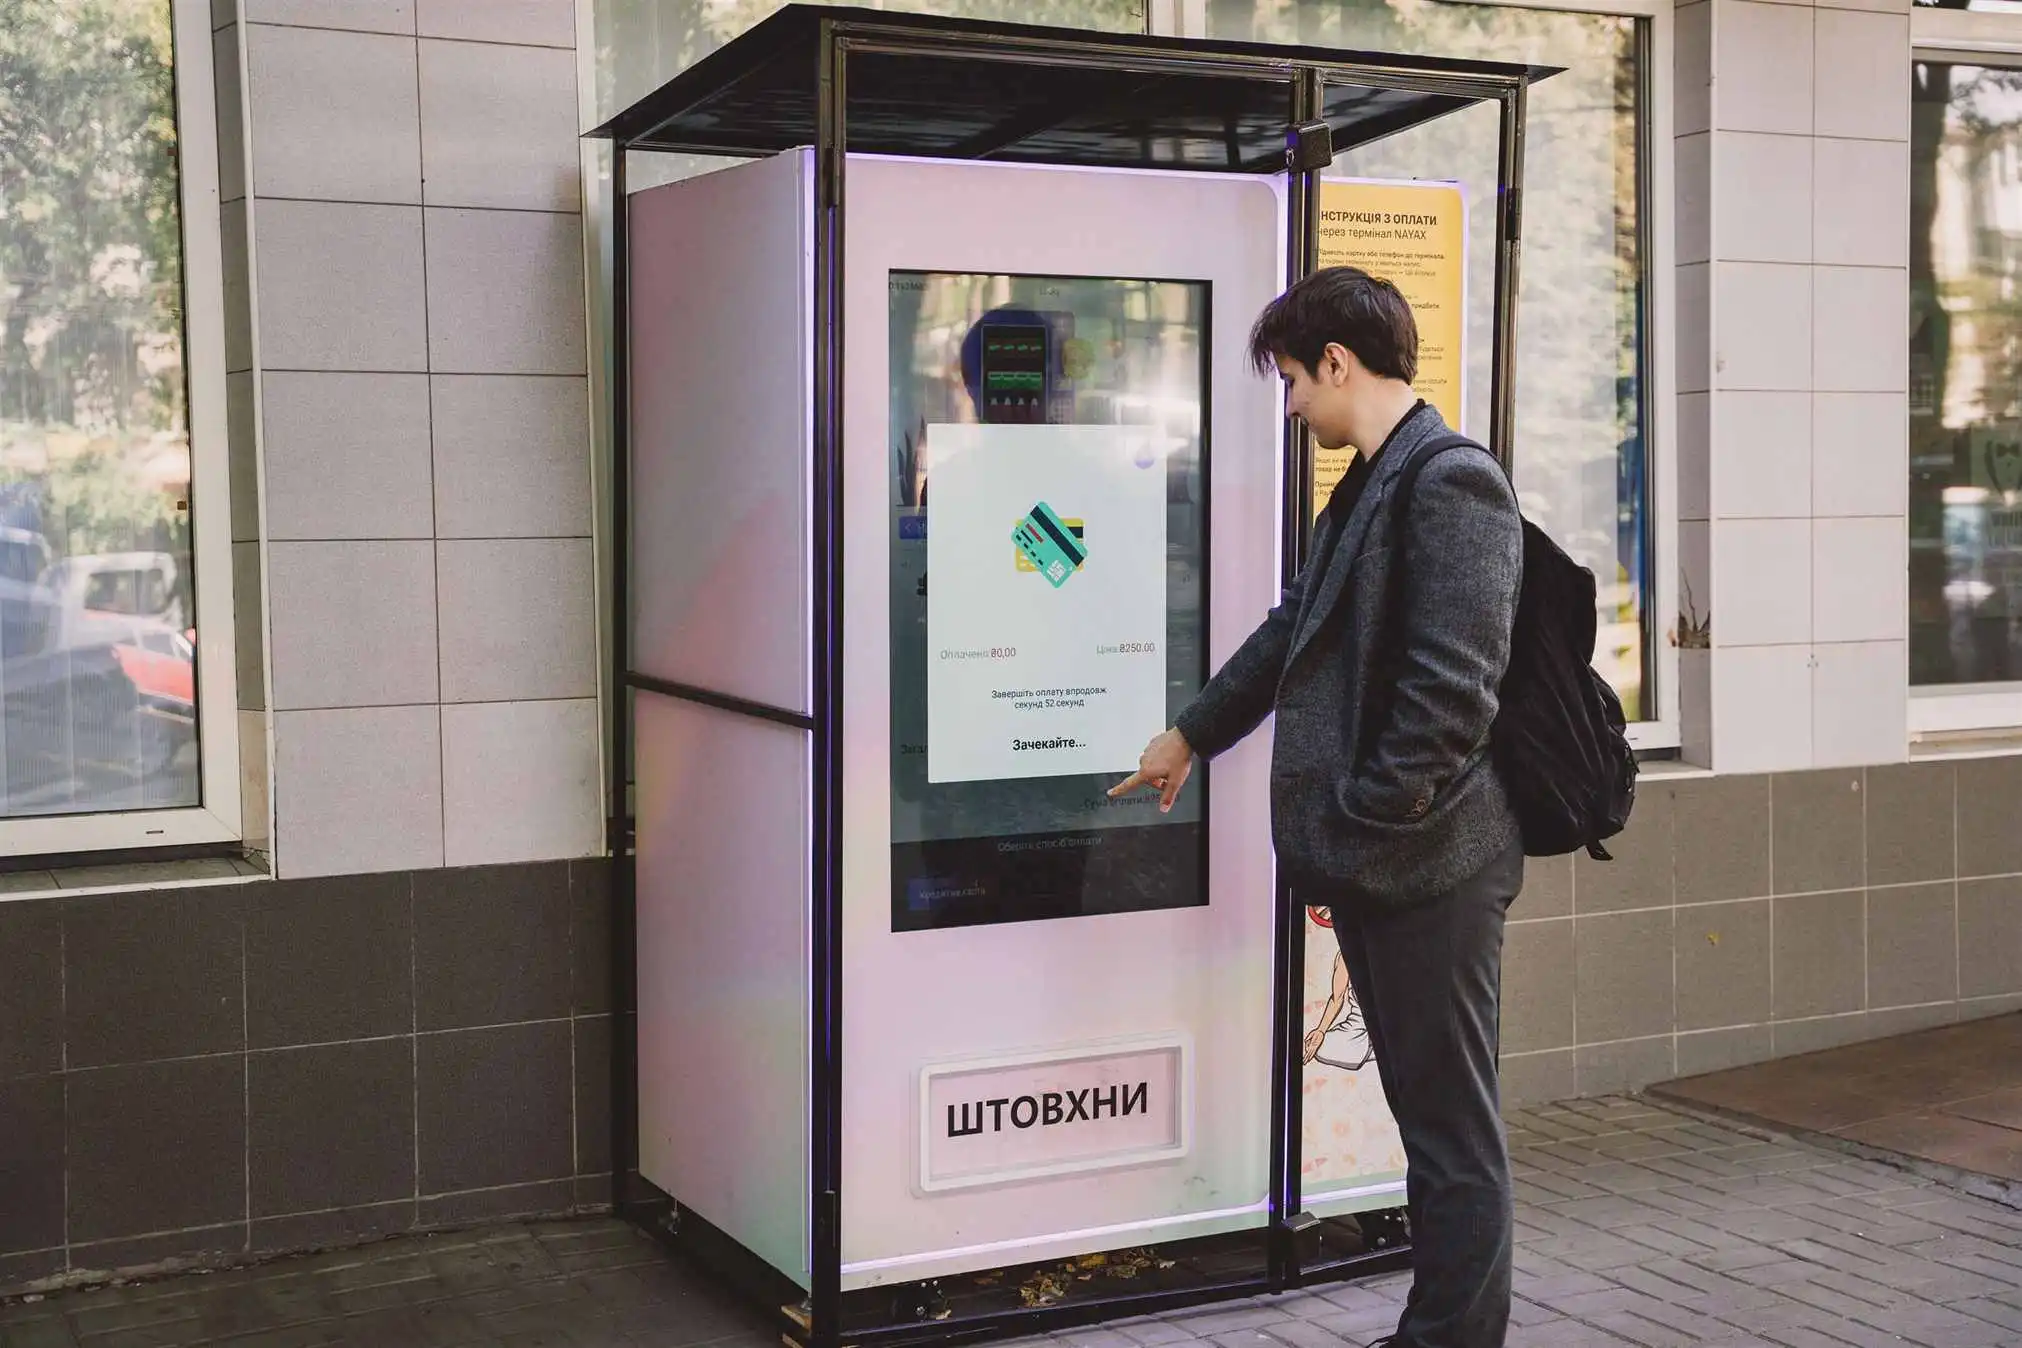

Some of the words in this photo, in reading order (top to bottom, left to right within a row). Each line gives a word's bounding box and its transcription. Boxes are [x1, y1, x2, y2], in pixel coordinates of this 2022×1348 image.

[1320, 210, 1381, 225] НСТРУКЦІЯ
[1383, 213, 1392, 224] З
[1393, 214, 1438, 226] ОПЛАТИ
[1348, 228, 1392, 239] термінал
[1394, 229, 1427, 240] NAYAX
[991, 688, 1034, 700] Завершіть
[1035, 688, 1064, 698] оплату
[1065, 687, 1108, 697] впродовж
[1014, 700, 1043, 710] секунд
[1045, 699, 1055, 707] 52
[1056, 699, 1085, 709] секунд
[947, 1081, 1148, 1138] ШТОВХНИ
